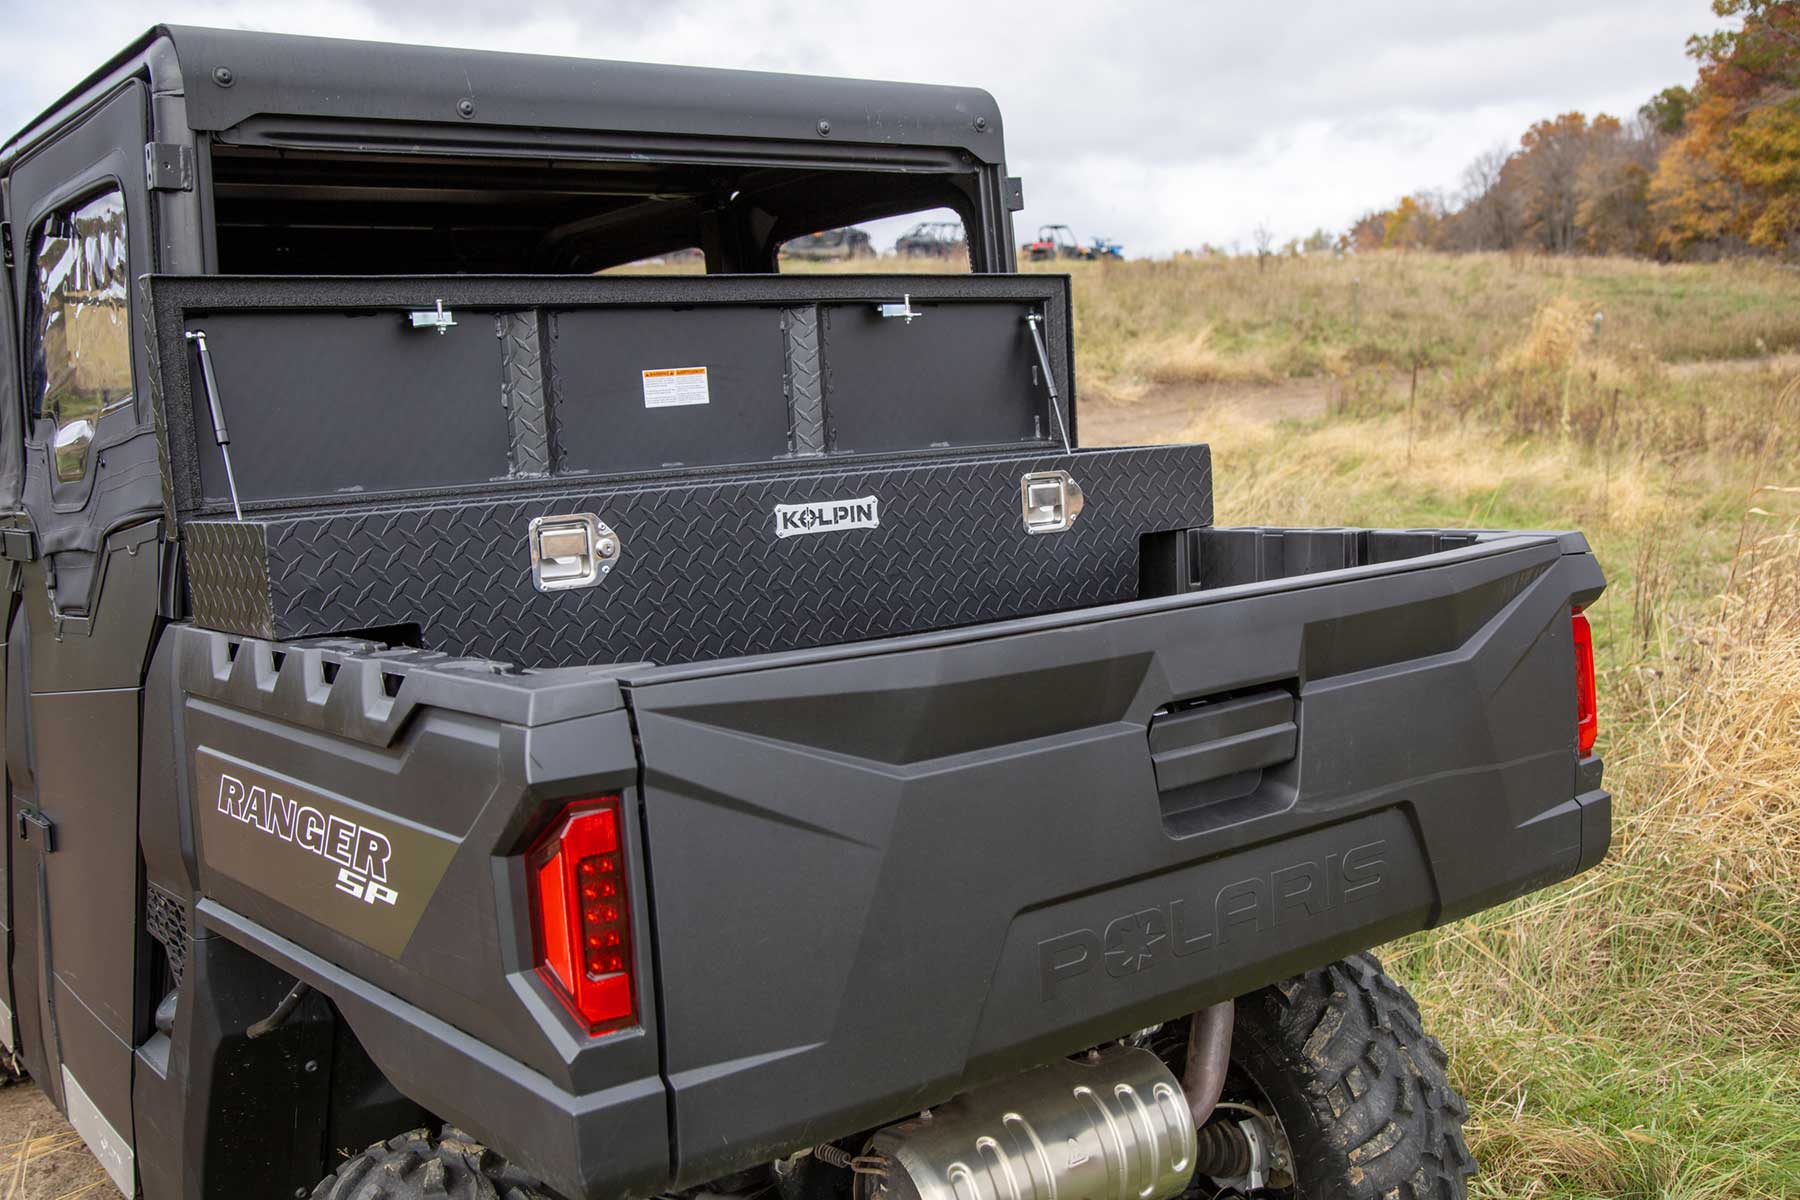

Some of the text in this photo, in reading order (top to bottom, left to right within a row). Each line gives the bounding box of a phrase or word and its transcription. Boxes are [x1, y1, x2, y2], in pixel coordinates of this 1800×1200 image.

[782, 504, 872, 530] KOLPIN
[218, 774, 391, 883] RANGER
[336, 868, 399, 905] SP
[1038, 839, 1391, 1001] POLARIS
